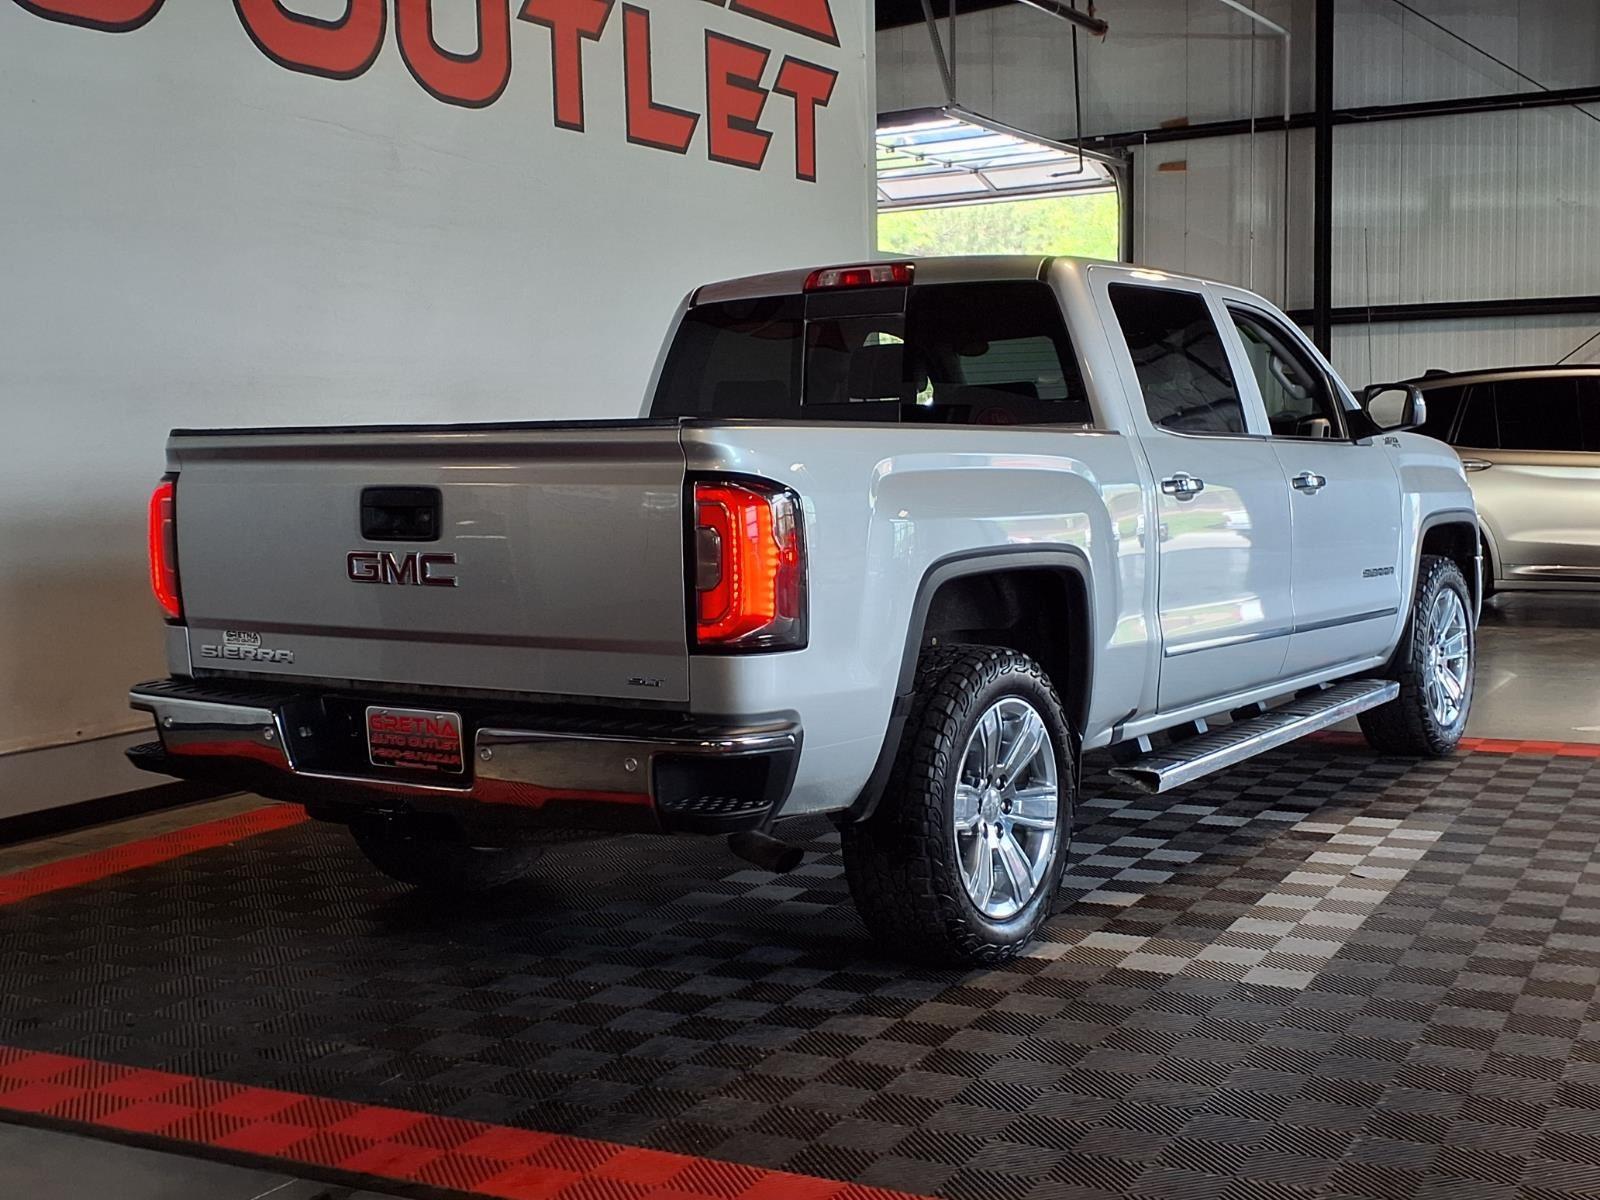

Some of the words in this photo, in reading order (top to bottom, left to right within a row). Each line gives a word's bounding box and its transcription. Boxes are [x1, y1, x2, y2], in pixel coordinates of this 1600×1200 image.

[346, 550, 458, 587] GMC
[200, 644, 295, 664] SIERRA
[370, 713, 458, 739] GRETNA
[371, 733, 406, 747] AUTO
[407, 735, 459, 752] OUTLET
